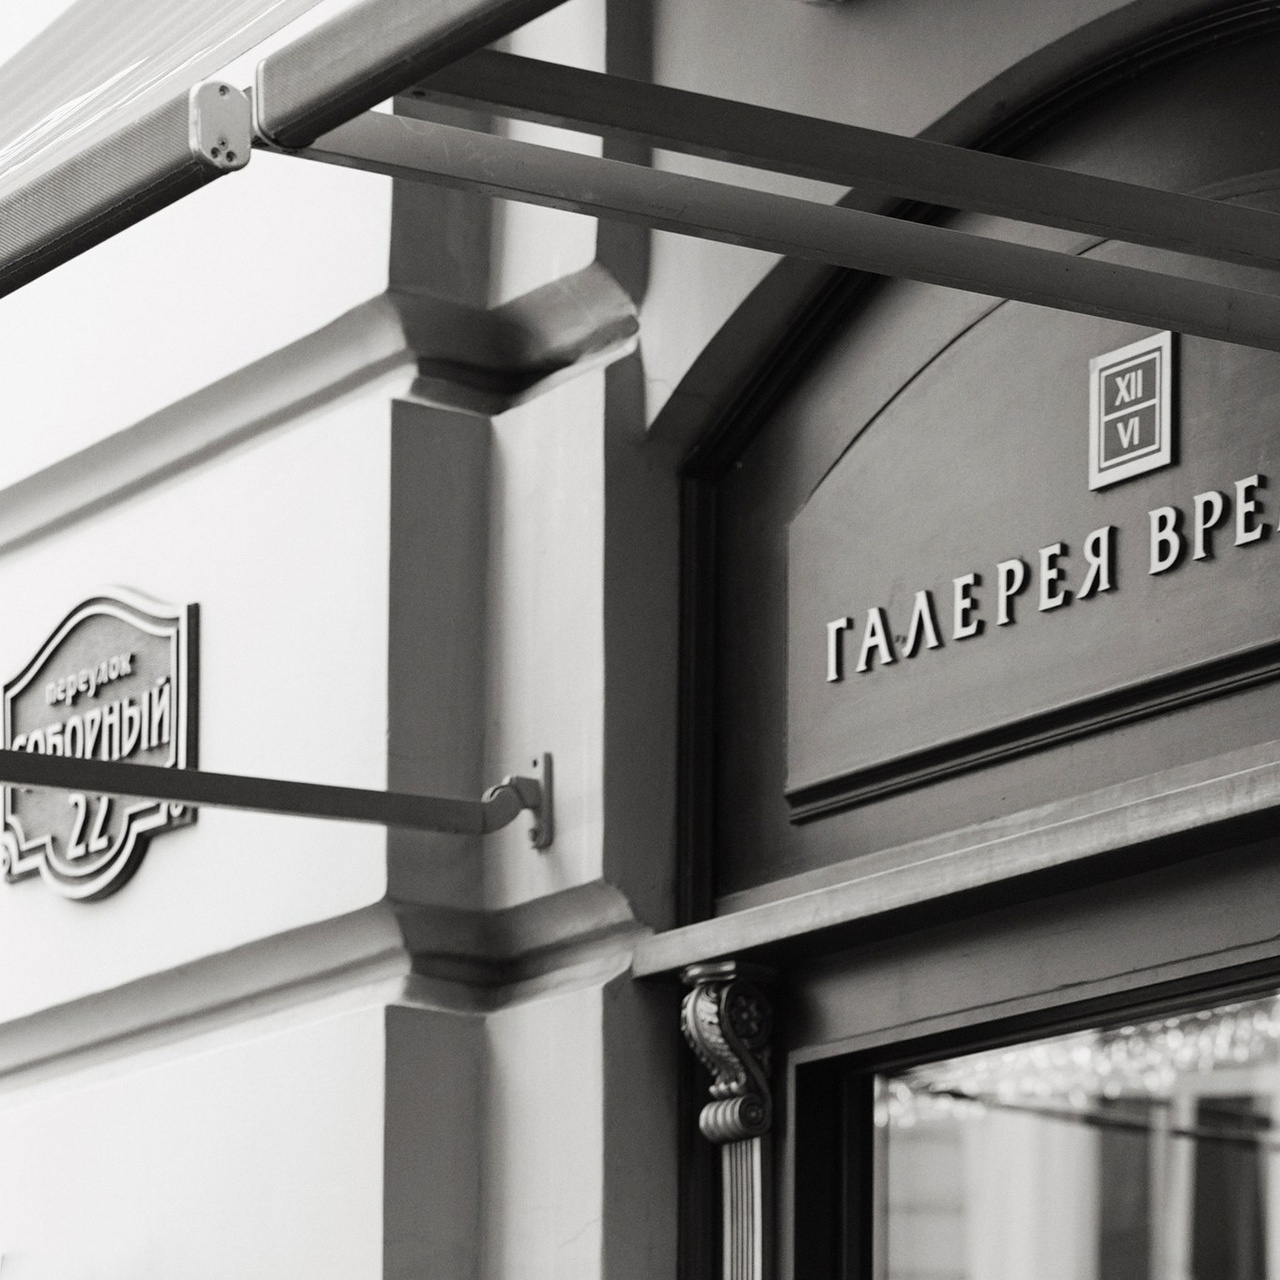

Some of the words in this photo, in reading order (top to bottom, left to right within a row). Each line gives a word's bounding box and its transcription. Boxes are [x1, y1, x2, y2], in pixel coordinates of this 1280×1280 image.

[1114, 369, 1143, 407] XII
[1116, 416, 1140, 449] VI
[826, 524, 1118, 683] ГАЛЕРЕЯ
[45, 652, 133, 707] переулок
[11, 675, 171, 763] БОРНЫЙ
[66, 793, 110, 861] 22
